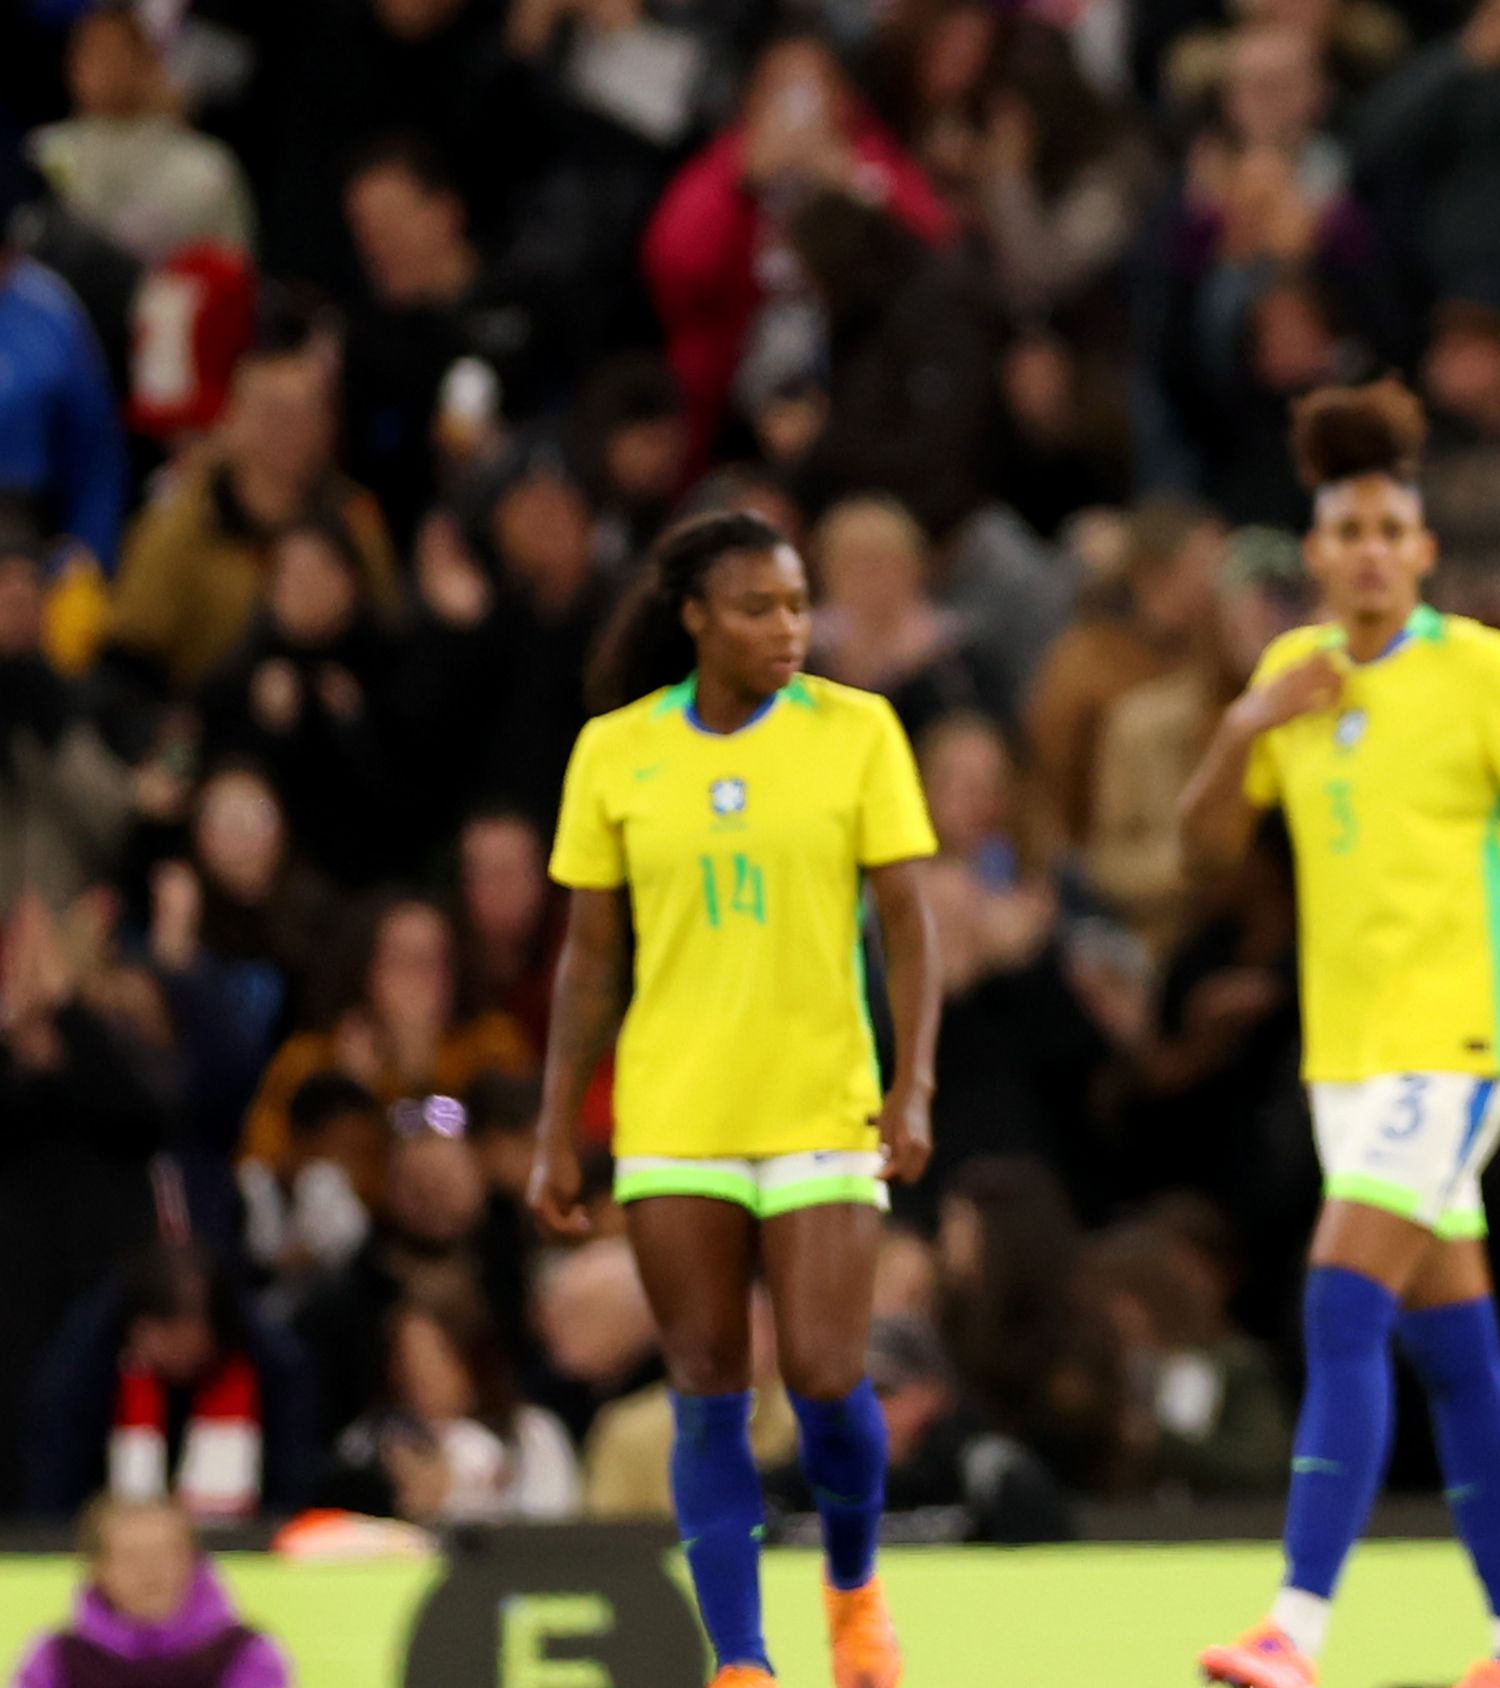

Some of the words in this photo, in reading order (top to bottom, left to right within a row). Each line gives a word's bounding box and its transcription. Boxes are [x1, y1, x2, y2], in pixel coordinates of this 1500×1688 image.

[1325, 778, 1360, 855] 3
[699, 853, 766, 928] 14
[1382, 1074, 1427, 1140] 3
